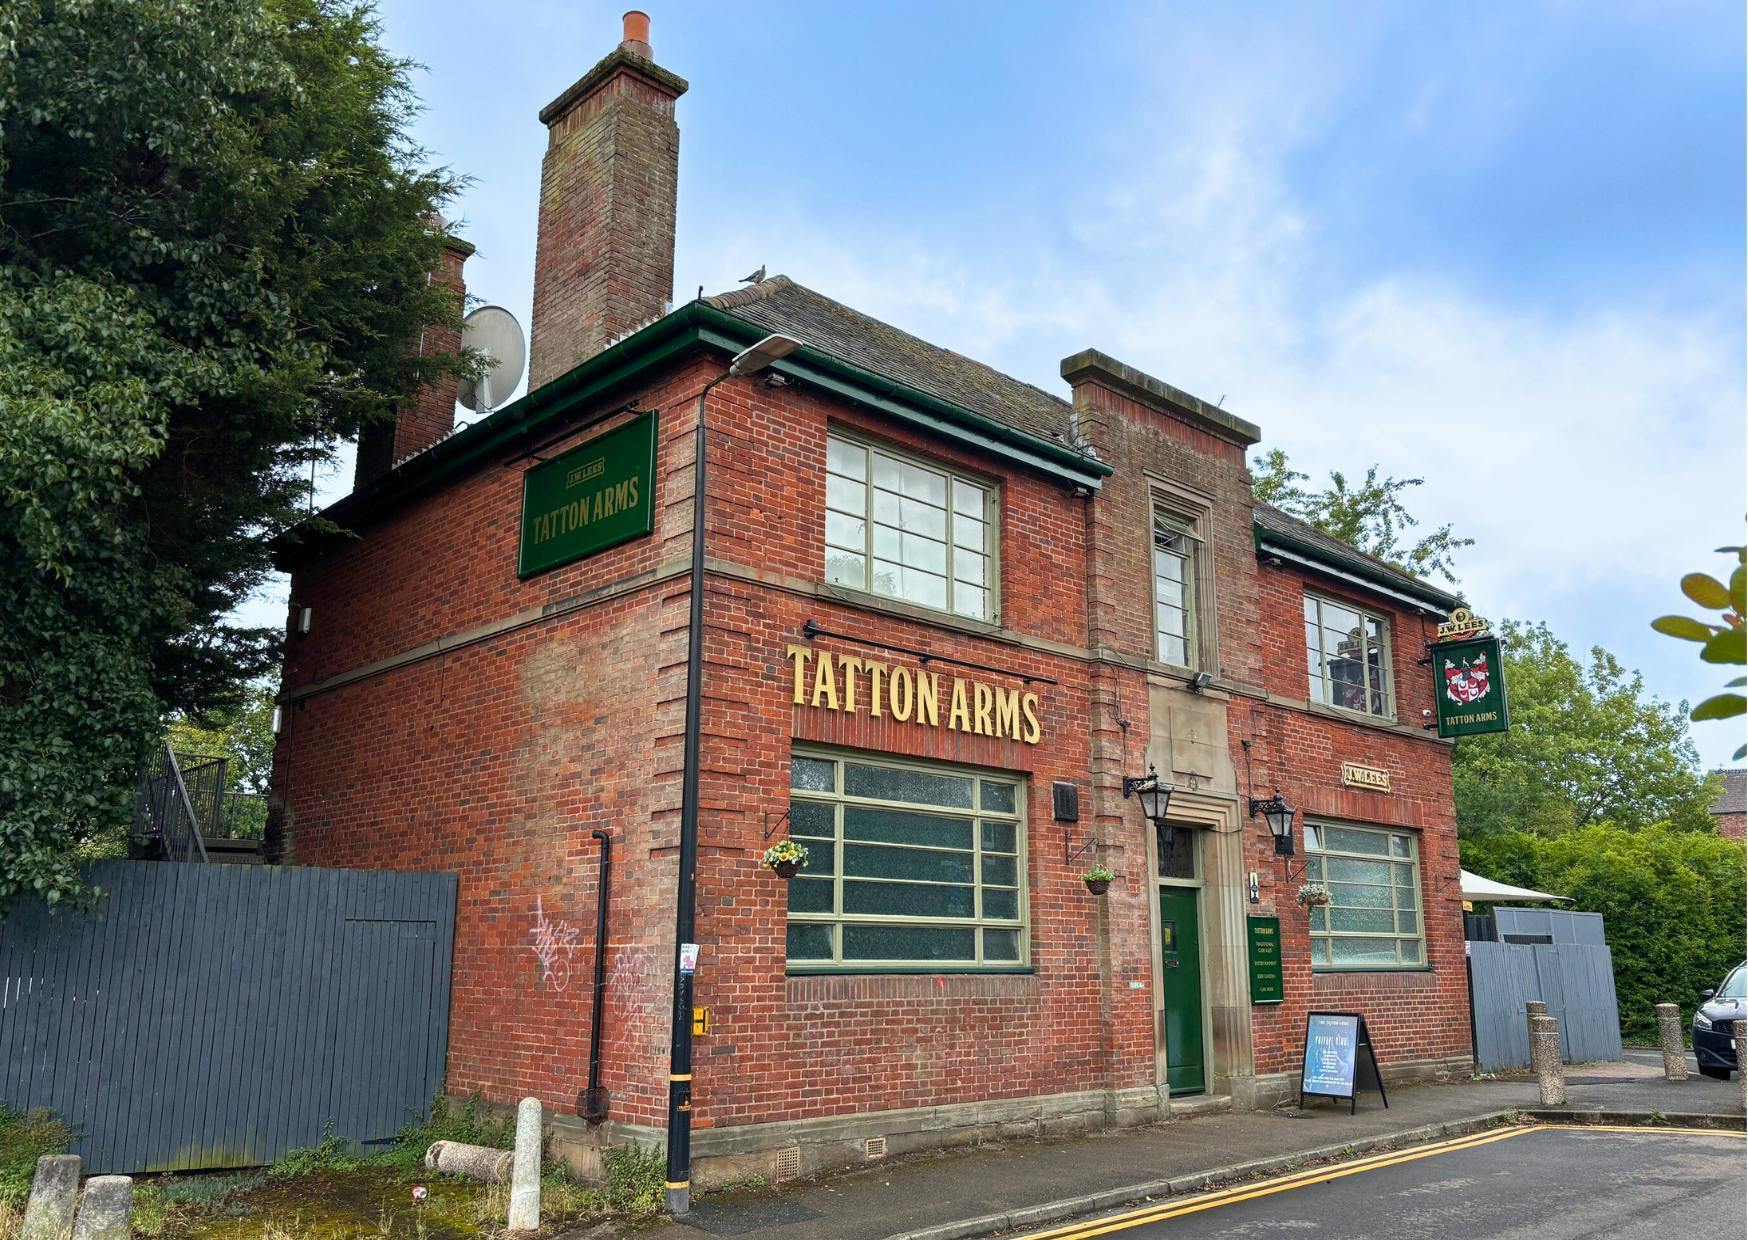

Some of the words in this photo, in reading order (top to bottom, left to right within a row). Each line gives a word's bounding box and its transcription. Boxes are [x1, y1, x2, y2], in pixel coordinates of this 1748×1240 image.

[532, 496, 591, 545] TATTON
[592, 476, 639, 523] ARMS
[787, 644, 939, 727] TATTON
[947, 677, 1041, 744] ARMS
[1445, 714, 1475, 726] TATTON
[1475, 711, 1498, 723] ARMS
